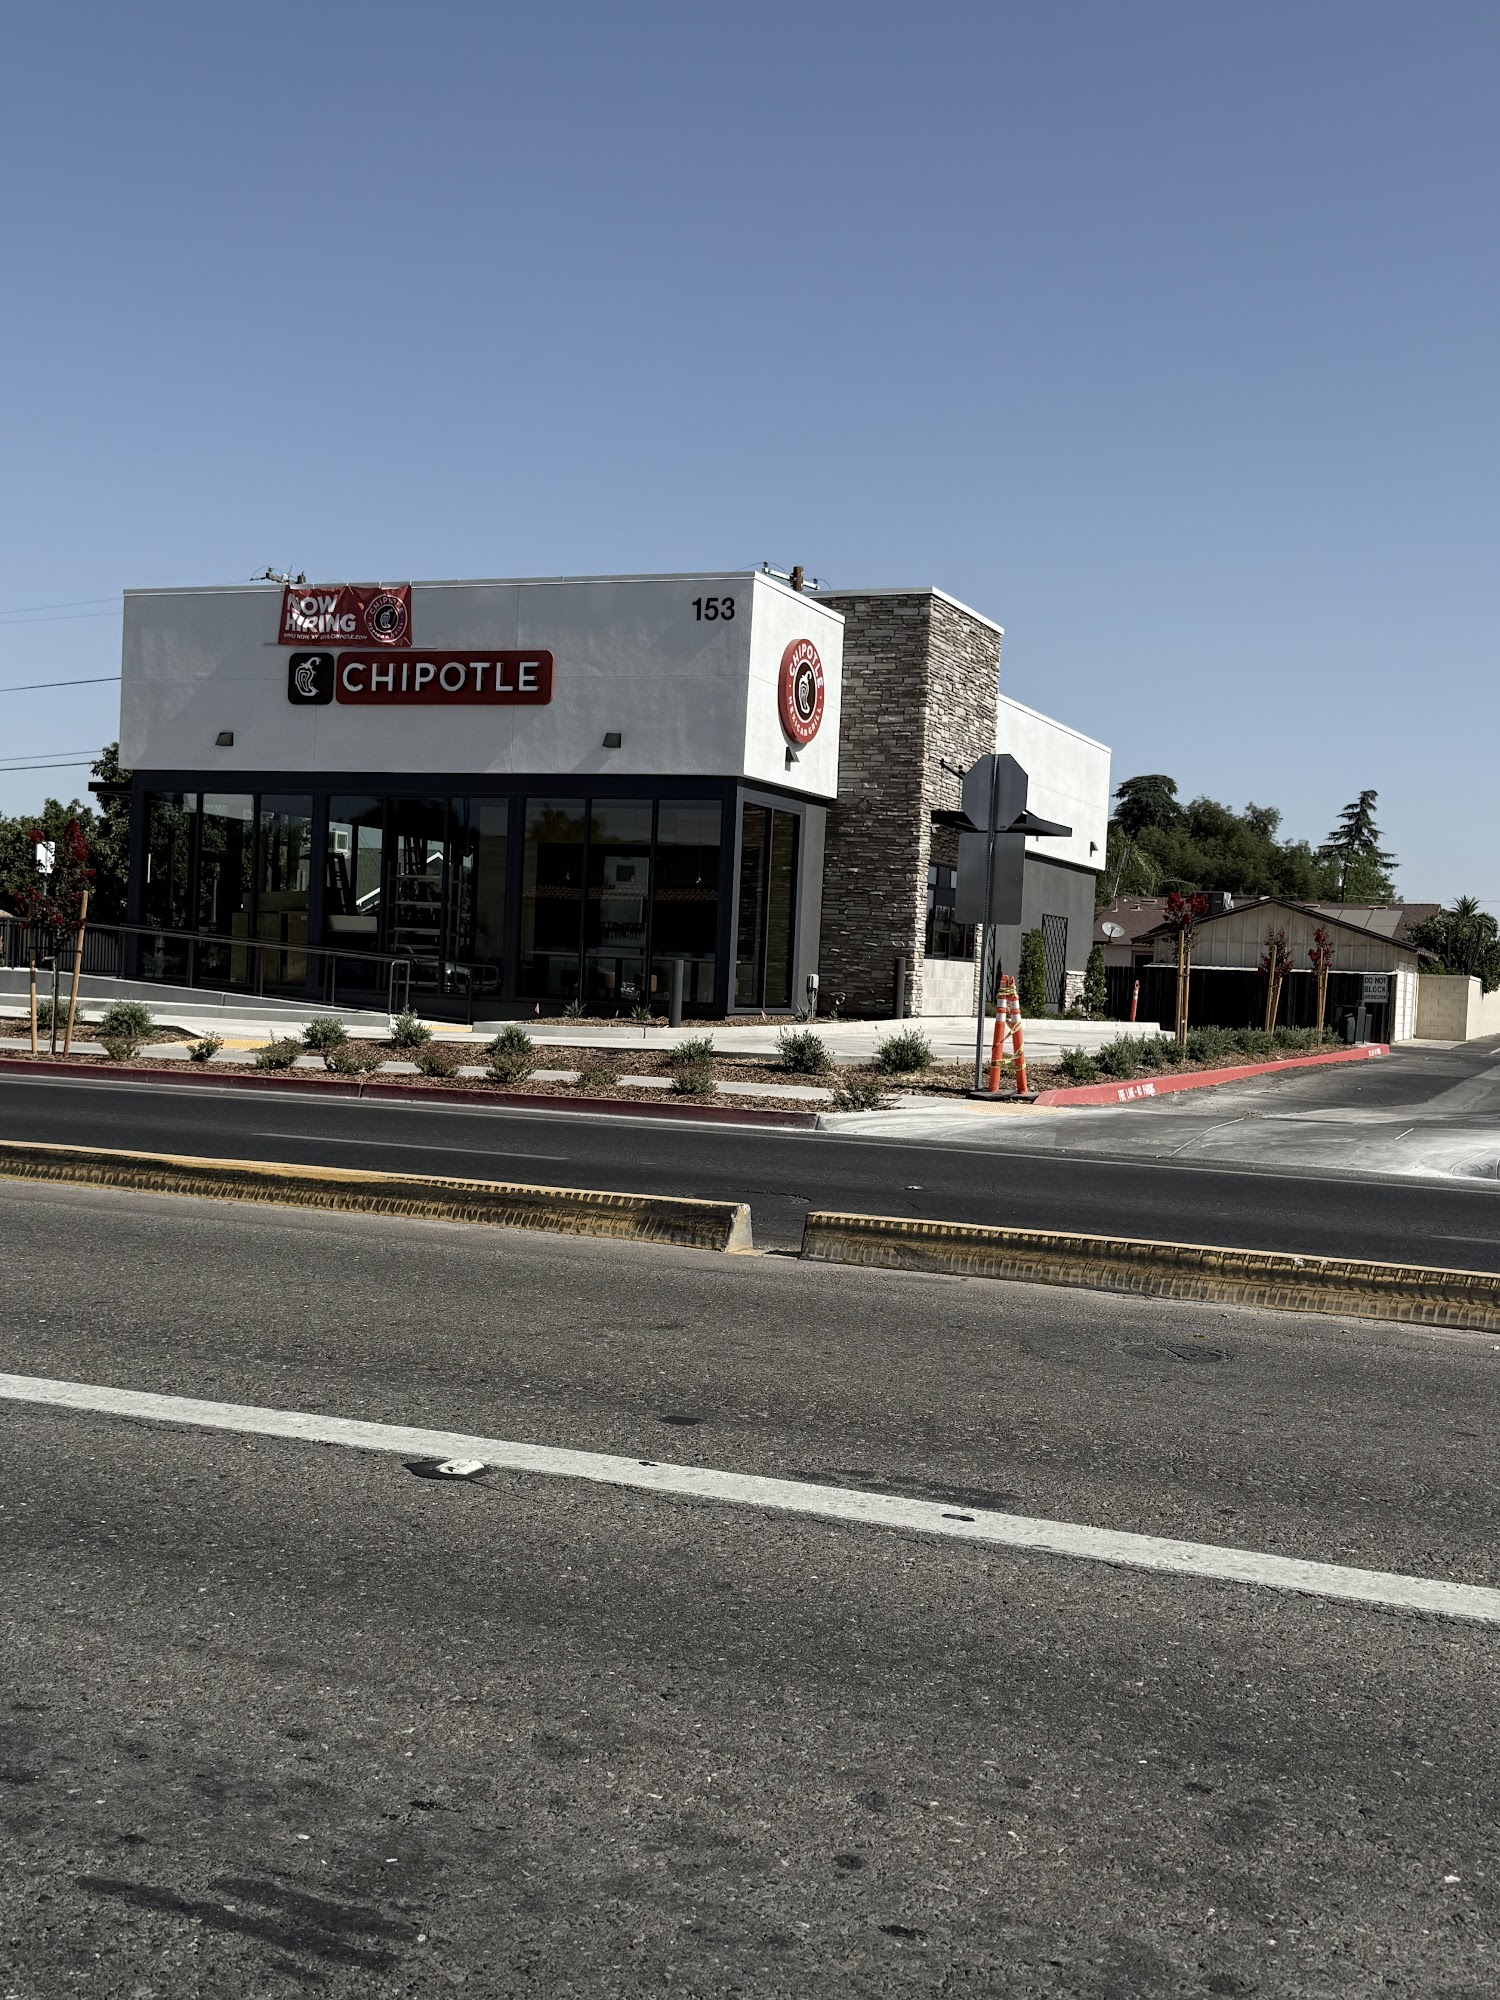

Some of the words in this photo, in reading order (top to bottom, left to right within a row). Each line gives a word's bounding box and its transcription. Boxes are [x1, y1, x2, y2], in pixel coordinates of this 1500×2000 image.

[287, 593, 338, 615] NOW
[692, 597, 735, 621] 153
[285, 612, 356, 633] HIRING
[342, 661, 540, 692] CHIPOTLE
[789, 643, 824, 688] CHIPOTLE
[788, 694, 808, 736] MEXICAN
[807, 707, 822, 736] GRILL
